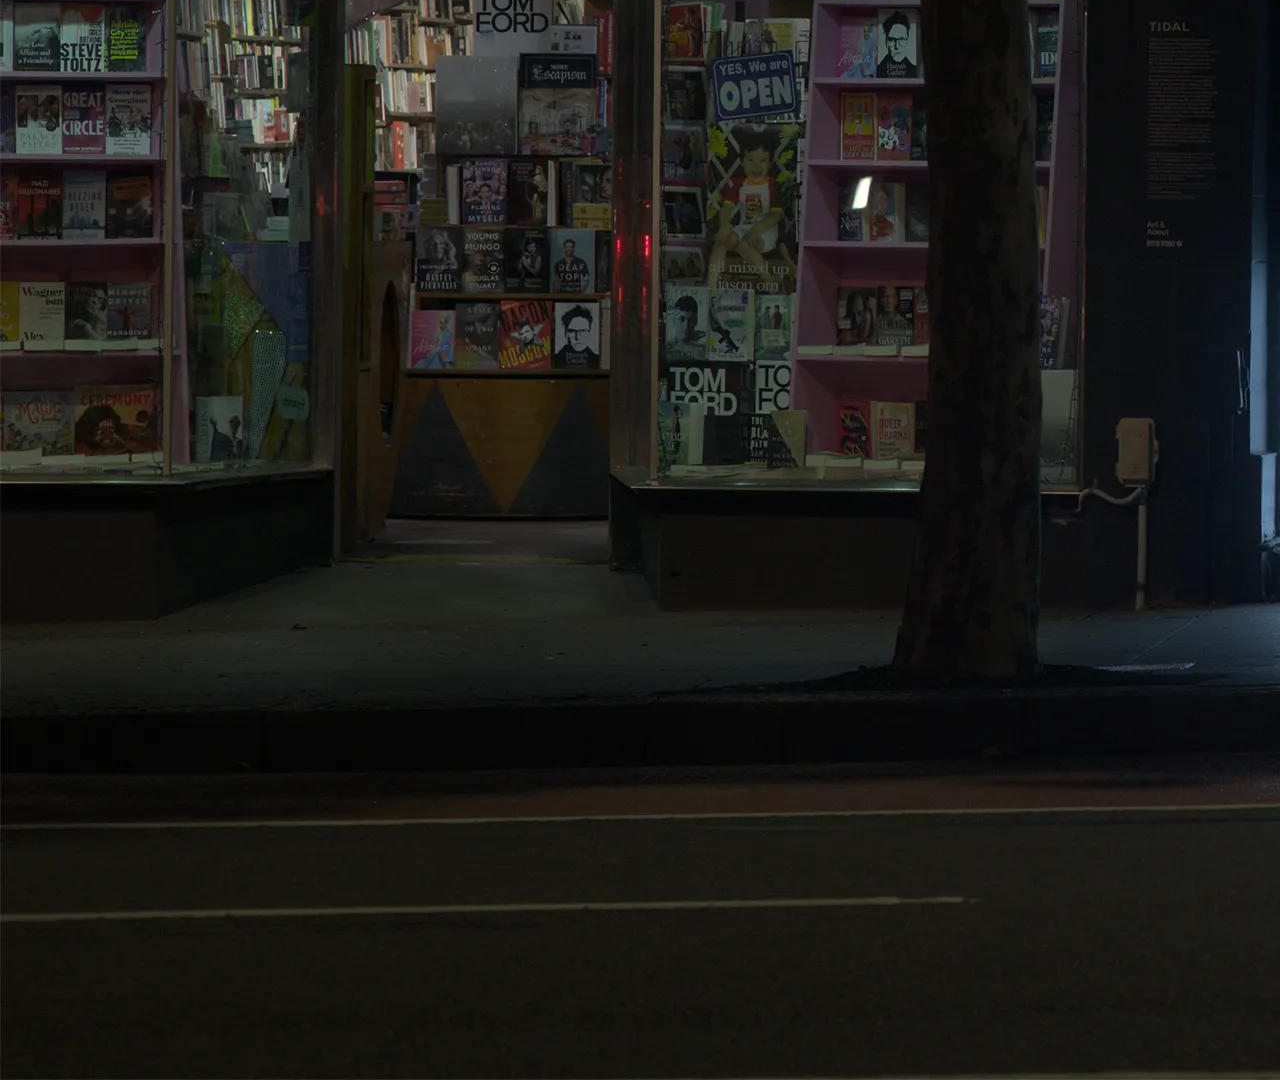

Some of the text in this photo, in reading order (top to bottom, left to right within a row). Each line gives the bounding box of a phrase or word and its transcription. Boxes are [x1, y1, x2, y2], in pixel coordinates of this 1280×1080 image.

[476, 12, 549, 33] FORD
[1148, 21, 1191, 32] TIDAL
[60, 43, 103, 58] STEVE
[23, 57, 54, 66] Friendship
[60, 57, 102, 72] TOLTZ
[748, 61, 767, 72] We
[770, 60, 789, 70] are
[532, 63, 587, 85] Escapism
[720, 75, 792, 111] OPEN
[63, 91, 103, 108] GREAT
[62, 120, 104, 136] CIRCLE
[18, 187, 61, 195] BILLIONAIRES
[467, 214, 505, 223] MYSELF
[466, 232, 500, 240] YOUNG
[464, 242, 501, 252] MUNGO
[558, 263, 584, 271] DEAF
[708, 259, 790, 279] all mixed up
[717, 276, 779, 292] jason om
[22, 287, 64, 299] Wagner
[107, 288, 149, 296] MINNIE
[107, 297, 149, 305] DRIVER
[24, 331, 45, 341] Alex
[878, 335, 911, 345] GARETH
[499, 336, 551, 369] MOSCOW
[669, 366, 727, 393] TOM
[81, 388, 151, 407] CEREMONY
[752, 416, 763, 426] THE
[878, 418, 903, 430] QUEER
[878, 431, 909, 440] DHARMA
